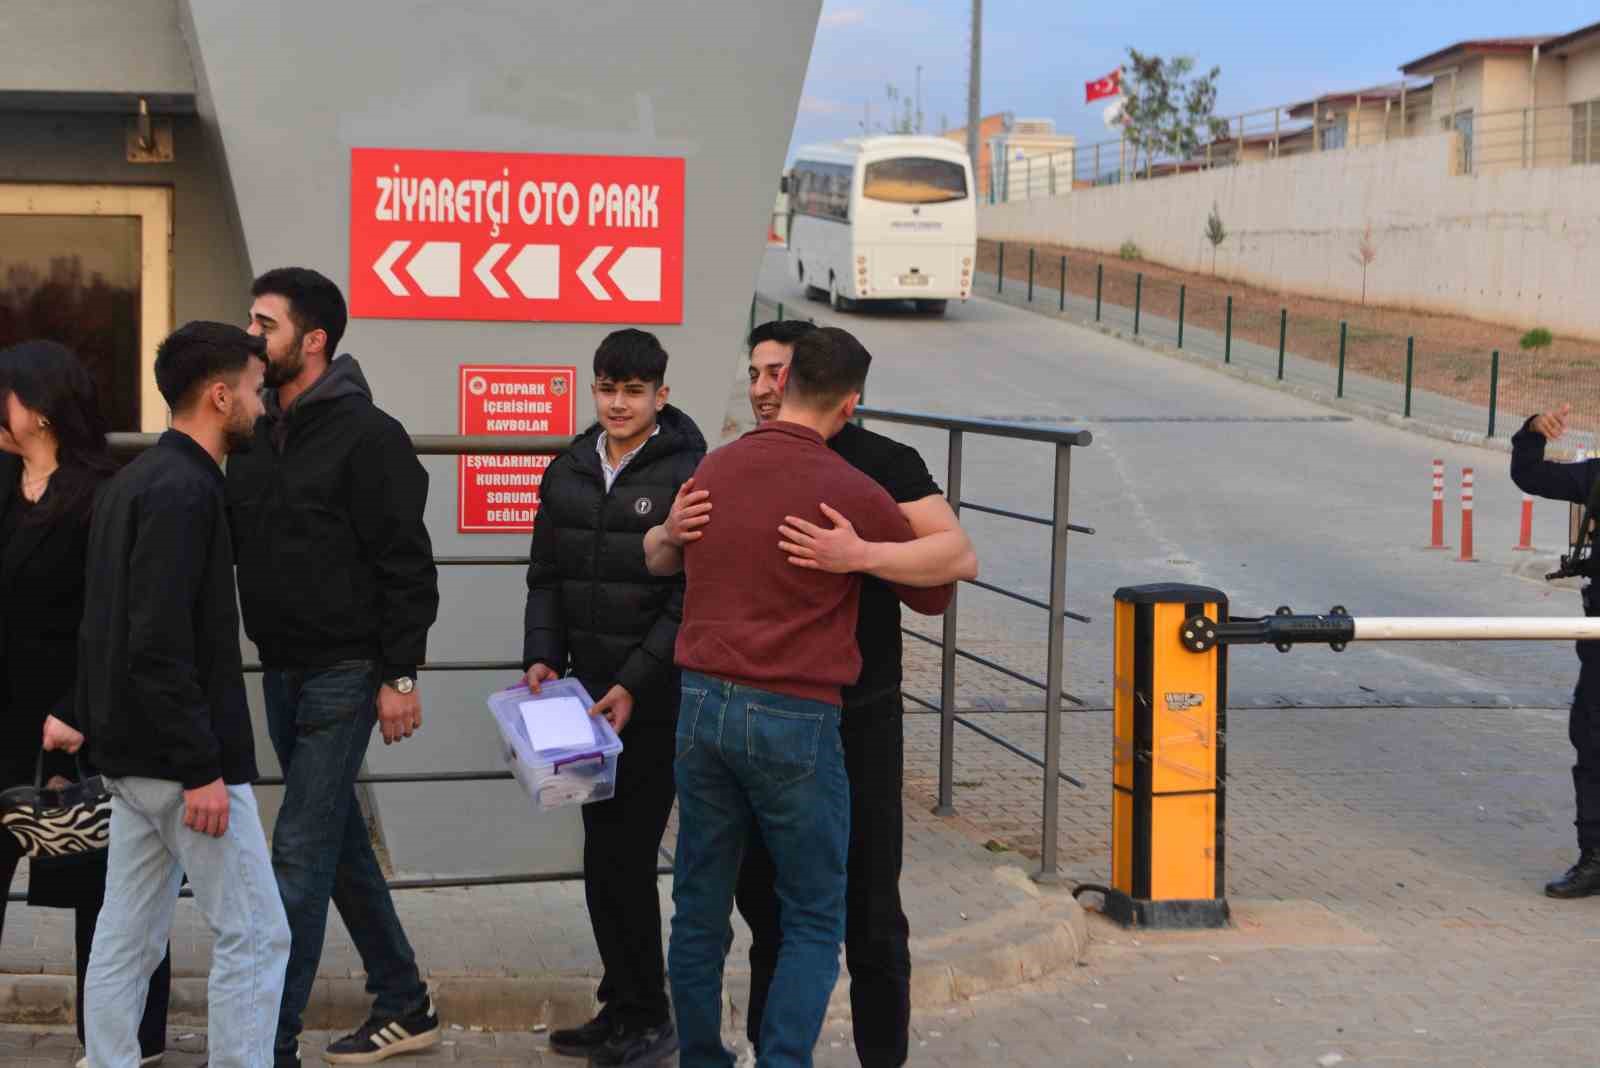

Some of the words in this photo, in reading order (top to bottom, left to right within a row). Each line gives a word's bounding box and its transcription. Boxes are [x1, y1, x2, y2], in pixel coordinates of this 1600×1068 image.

[375, 164, 510, 238] ZİYARETÇİ
[518, 181, 580, 226] OTO
[588, 183, 660, 228] PARK
[490, 383, 545, 395] OTOPARK
[483, 400, 553, 415] İÇERİSİNDE
[487, 420, 549, 431] KAYBOLAN
[467, 456, 556, 469] EŞYALARINIZD
[476, 474, 543, 486] KURUMUM
[487, 492, 541, 504] SORUML
[487, 509, 538, 522] DEĞİLDİ
